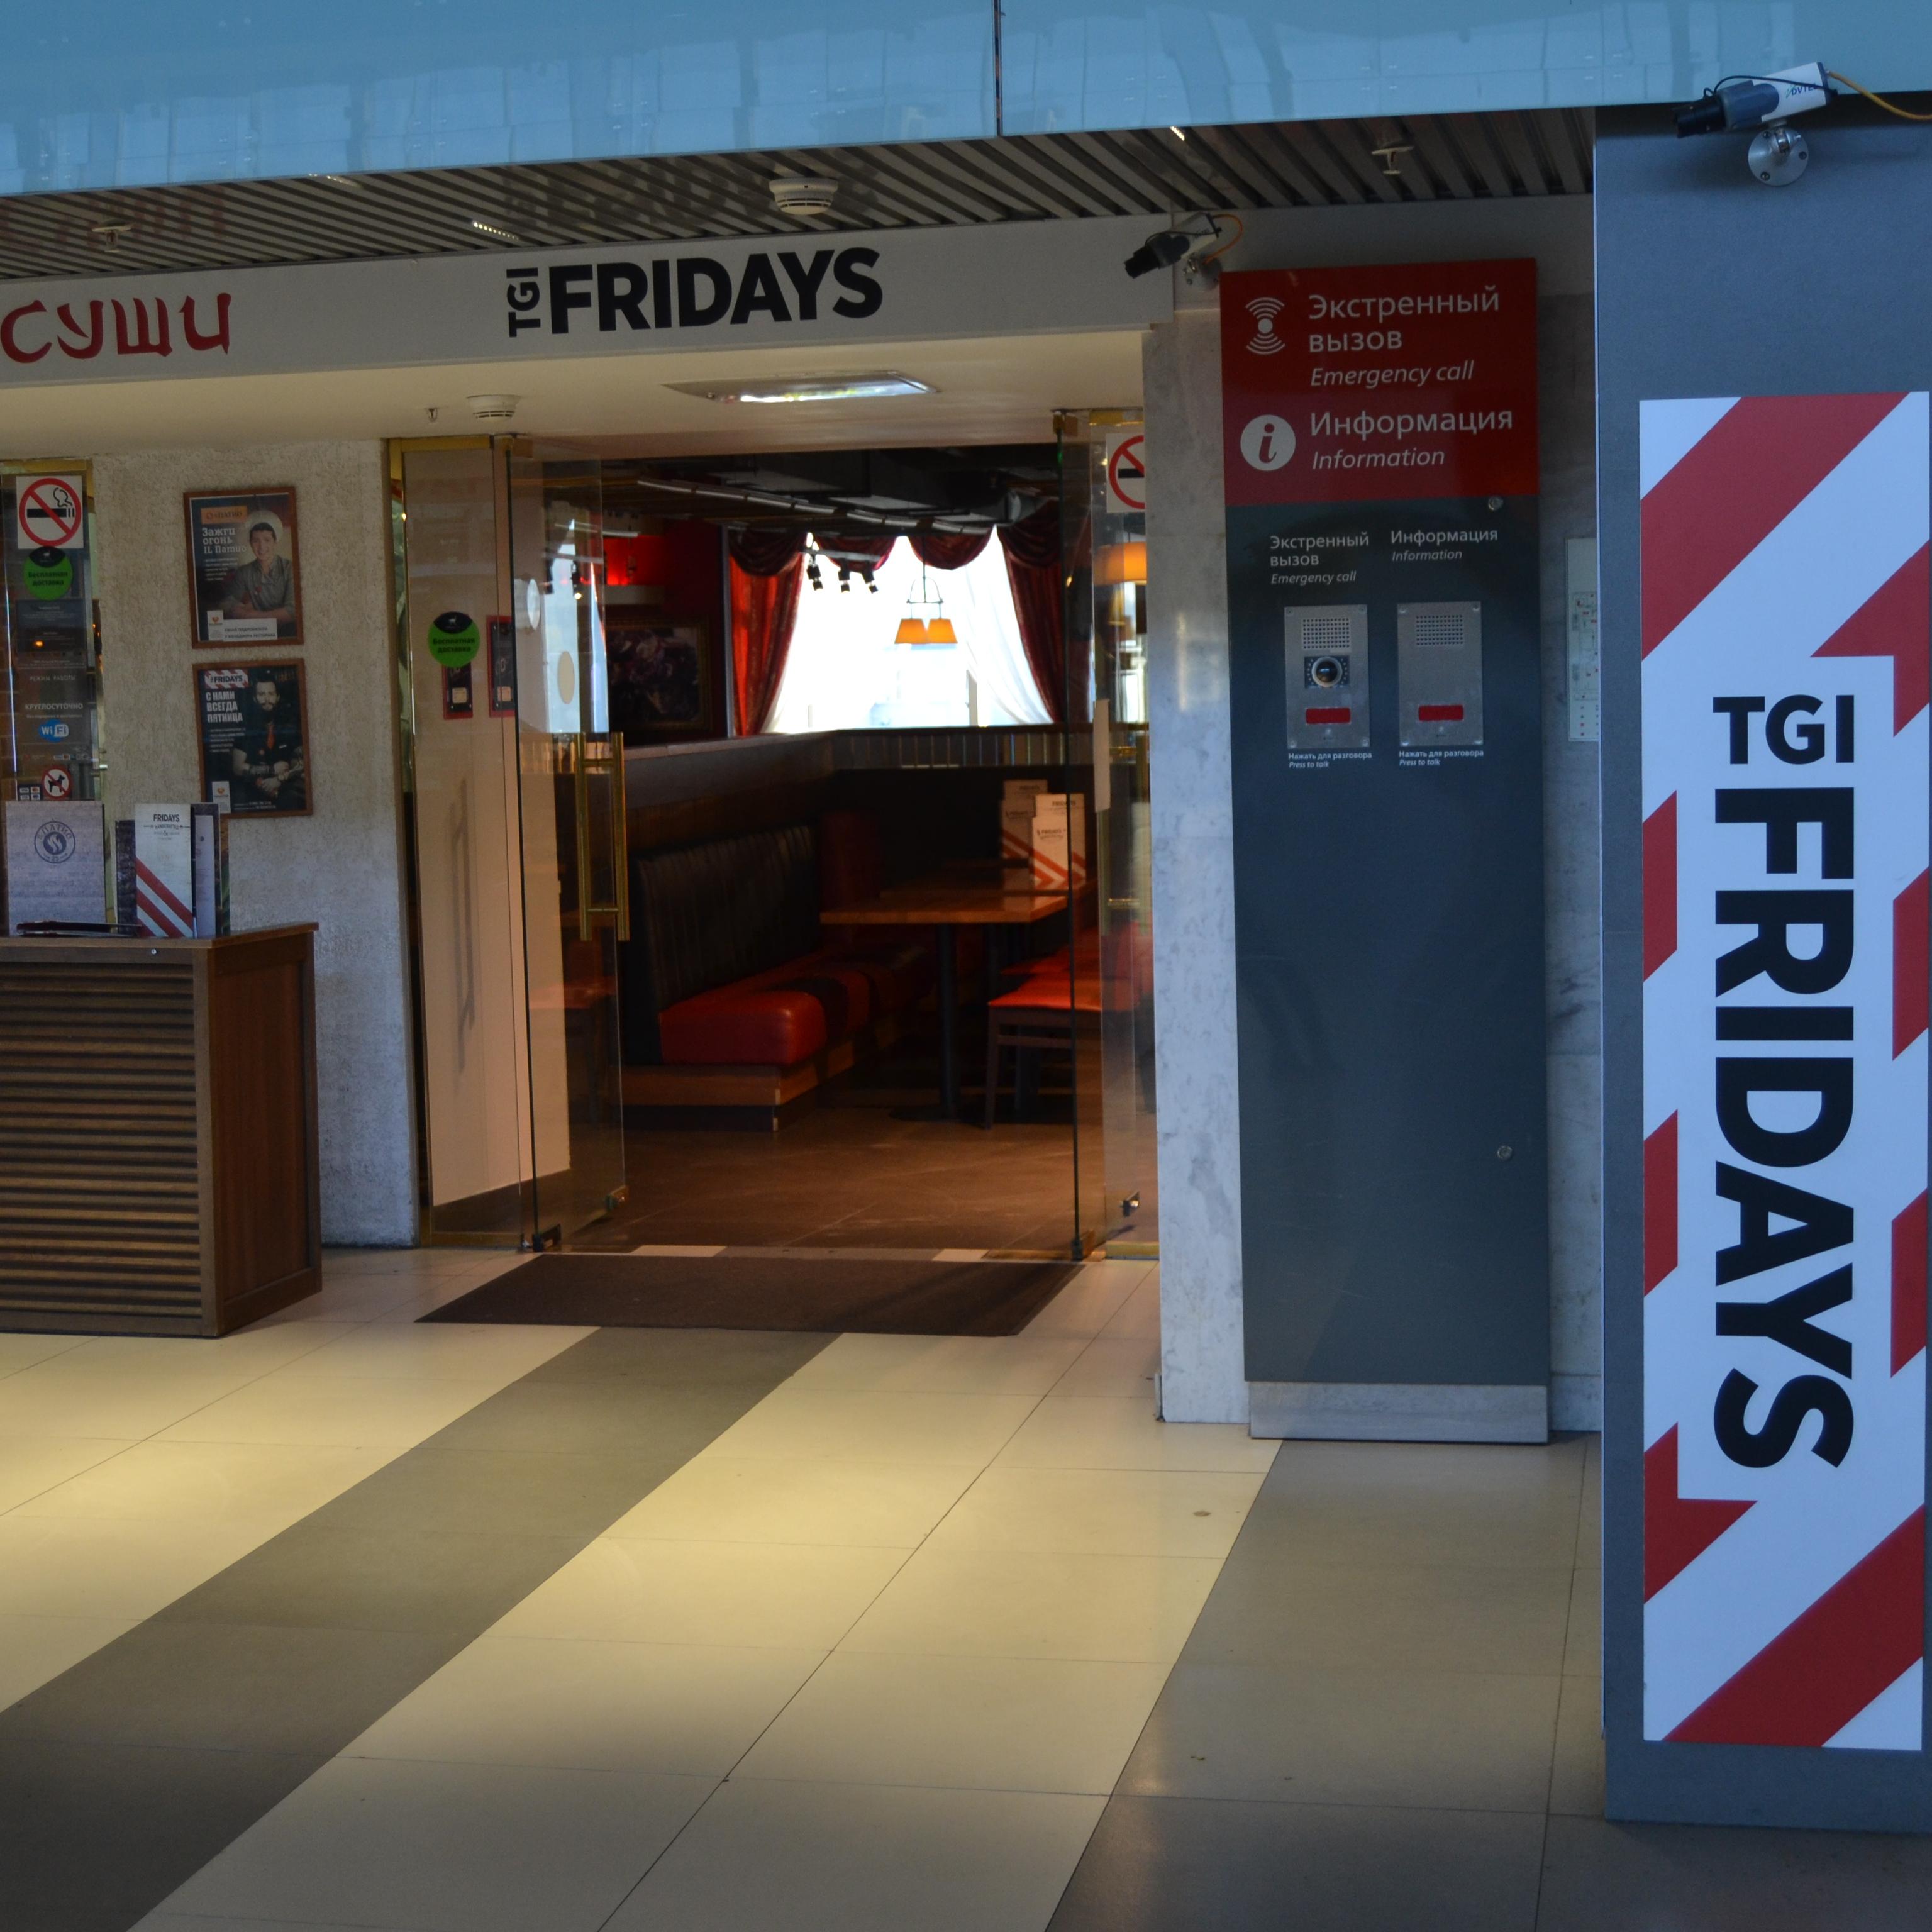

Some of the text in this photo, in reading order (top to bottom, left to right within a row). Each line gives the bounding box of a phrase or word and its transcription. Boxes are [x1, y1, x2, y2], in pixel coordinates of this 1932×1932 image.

[1791, 85, 1815, 95] DVTE
[506, 247, 883, 337] TGI FRIDAYS
[1309, 285, 1499, 323] Экстренный
[1309, 331, 1402, 353] вызов
[1311, 360, 1475, 389] Emergency call
[1311, 410, 1513, 441] Информация
[1313, 448, 1445, 469] Information
[201, 527, 236, 536] Зажги
[1391, 530, 1498, 547] Информация
[203, 536, 233, 545] огонь
[1270, 531, 1369, 550] Экстренный
[1270, 555, 1319, 567] вызов
[1392, 550, 1463, 562] Information
[1270, 571, 1357, 587] Emergency call
[213, 691, 235, 701] НАМИ
[207, 701, 238, 712] ВСЕГДА
[208, 713, 243, 723] ПЯТНИЦА
[1713, 694, 1855, 765] TGI
[1288, 752, 1372, 761] Нажать для разговора
[1399, 750, 1427, 758] Нажать
[1444, 750, 1484, 759] разговора
[153, 814, 180, 822] FRIDAYS
[1713, 787, 1855, 1468] FRIDAYS
